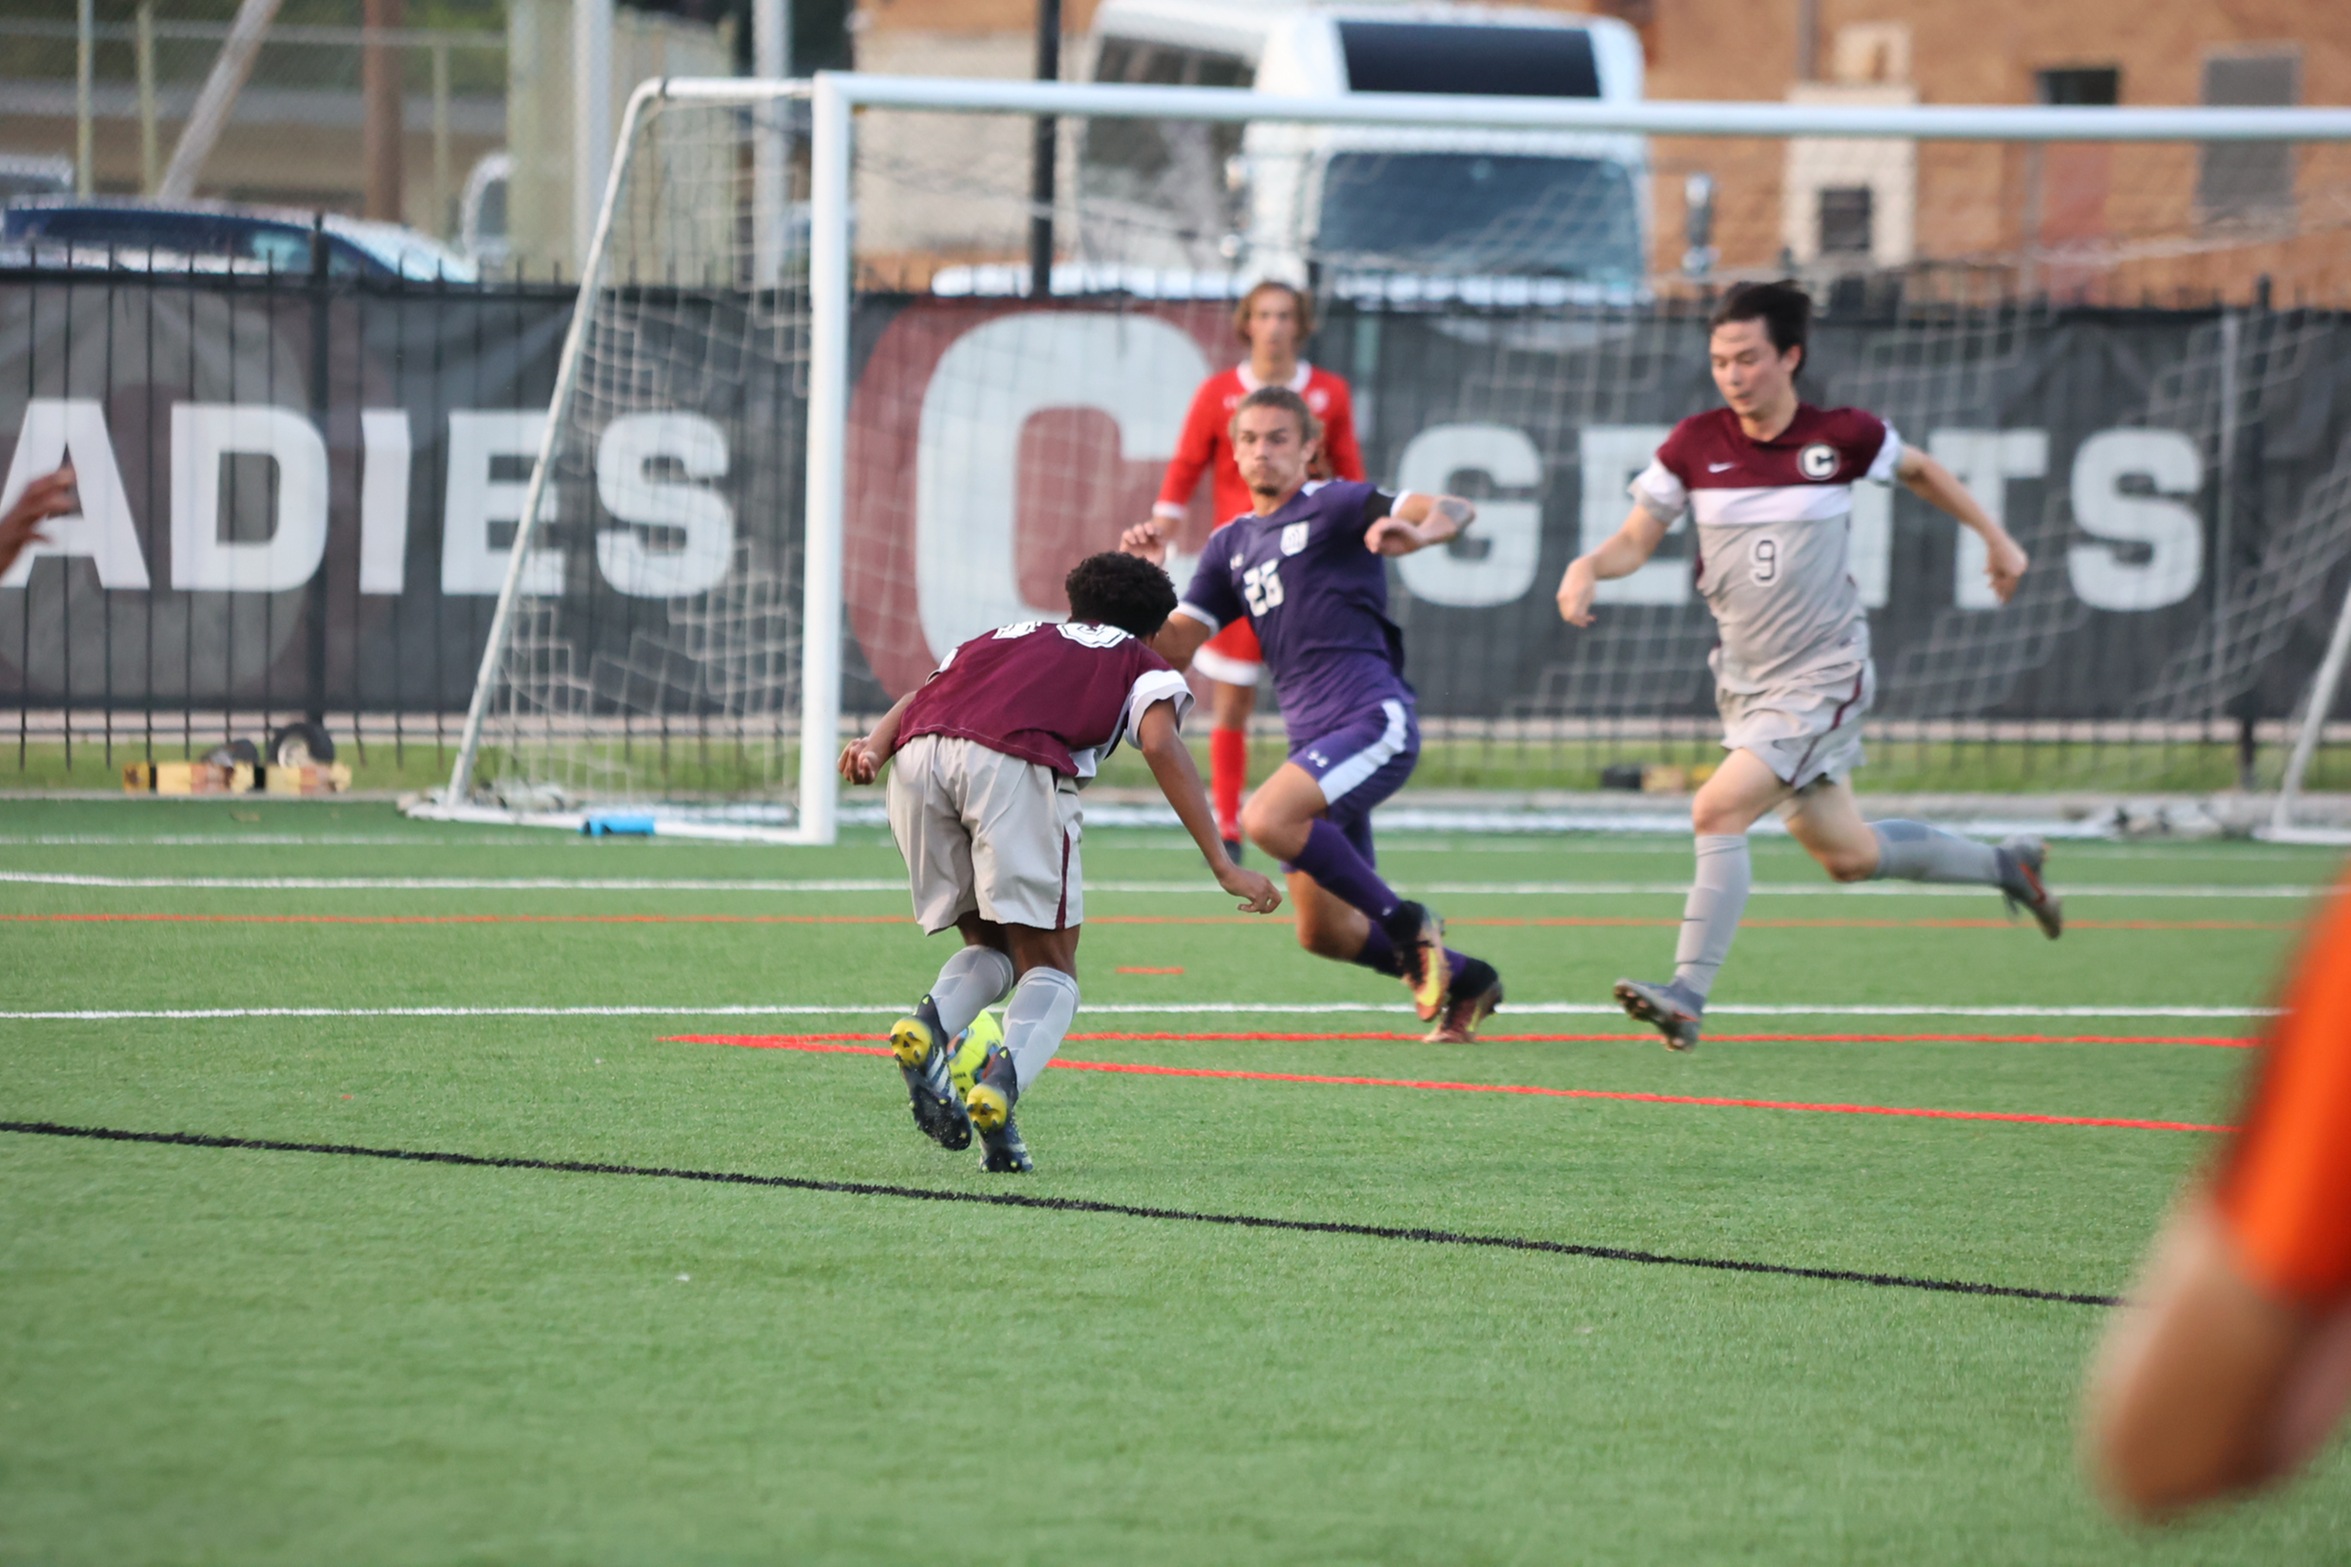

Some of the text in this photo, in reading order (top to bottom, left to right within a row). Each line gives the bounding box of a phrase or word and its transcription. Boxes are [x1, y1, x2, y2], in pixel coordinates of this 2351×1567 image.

[0, 398, 734, 598] ADIES
[916, 311, 1215, 668] C
[1803, 445, 1835, 478] C
[1753, 537, 1779, 584] 9
